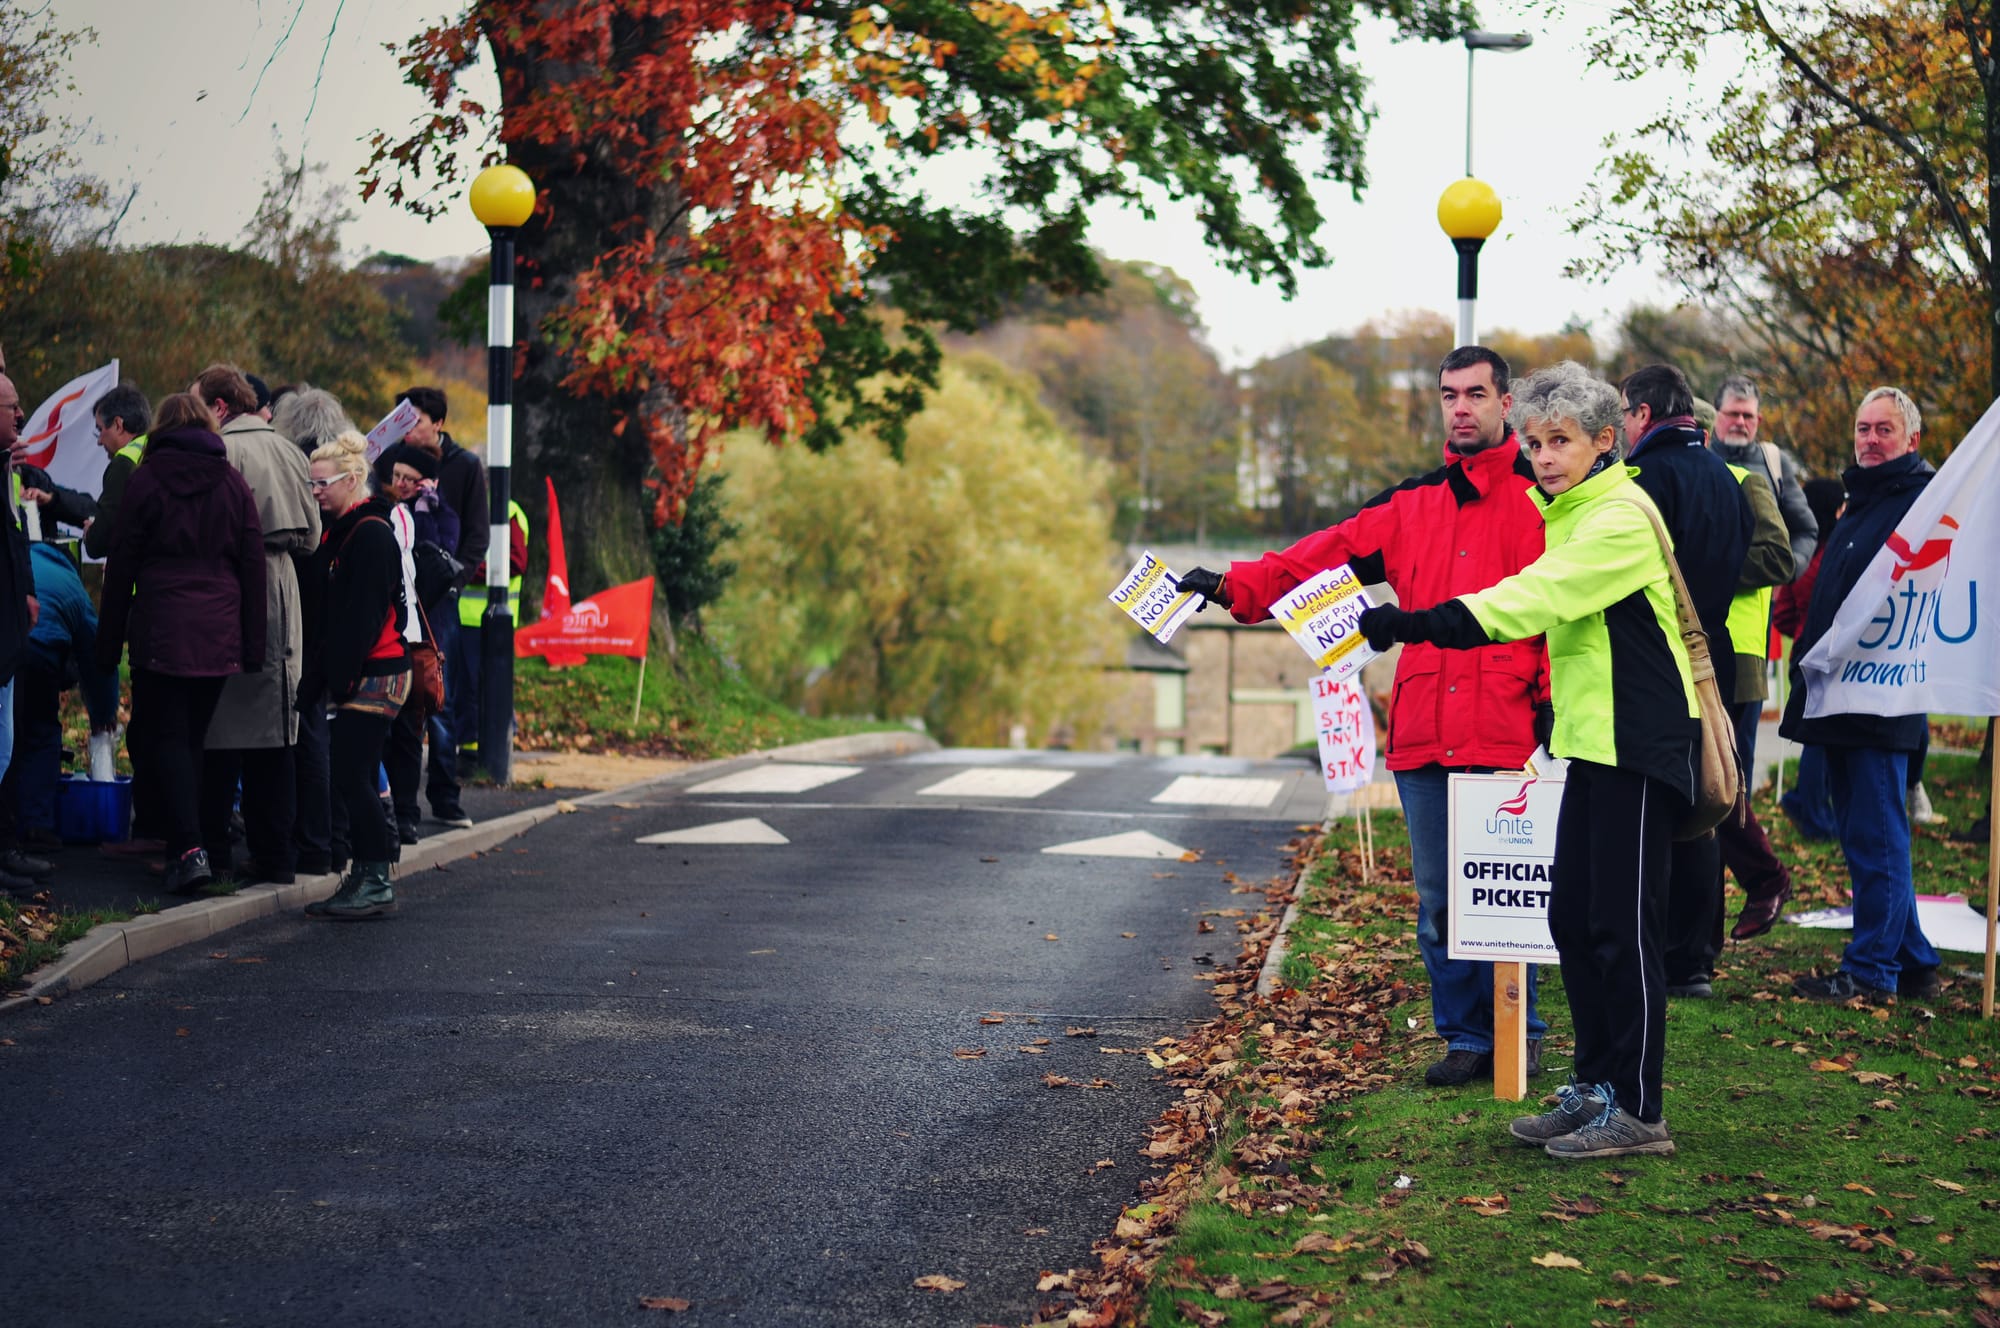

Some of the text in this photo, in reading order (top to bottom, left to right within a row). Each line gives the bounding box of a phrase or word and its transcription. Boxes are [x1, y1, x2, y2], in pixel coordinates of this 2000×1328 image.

[1114, 555, 1157, 603] United
[1131, 566, 1164, 603] Education
[1291, 569, 1353, 610] United
[1132, 598, 1151, 616] Fair
[1149, 581, 1168, 600] Pay
[1309, 584, 1359, 615] Education
[1308, 601, 1355, 633] Fair Pay
[1486, 817, 1534, 836] unite
[1472, 888, 1551, 908] PICKET
